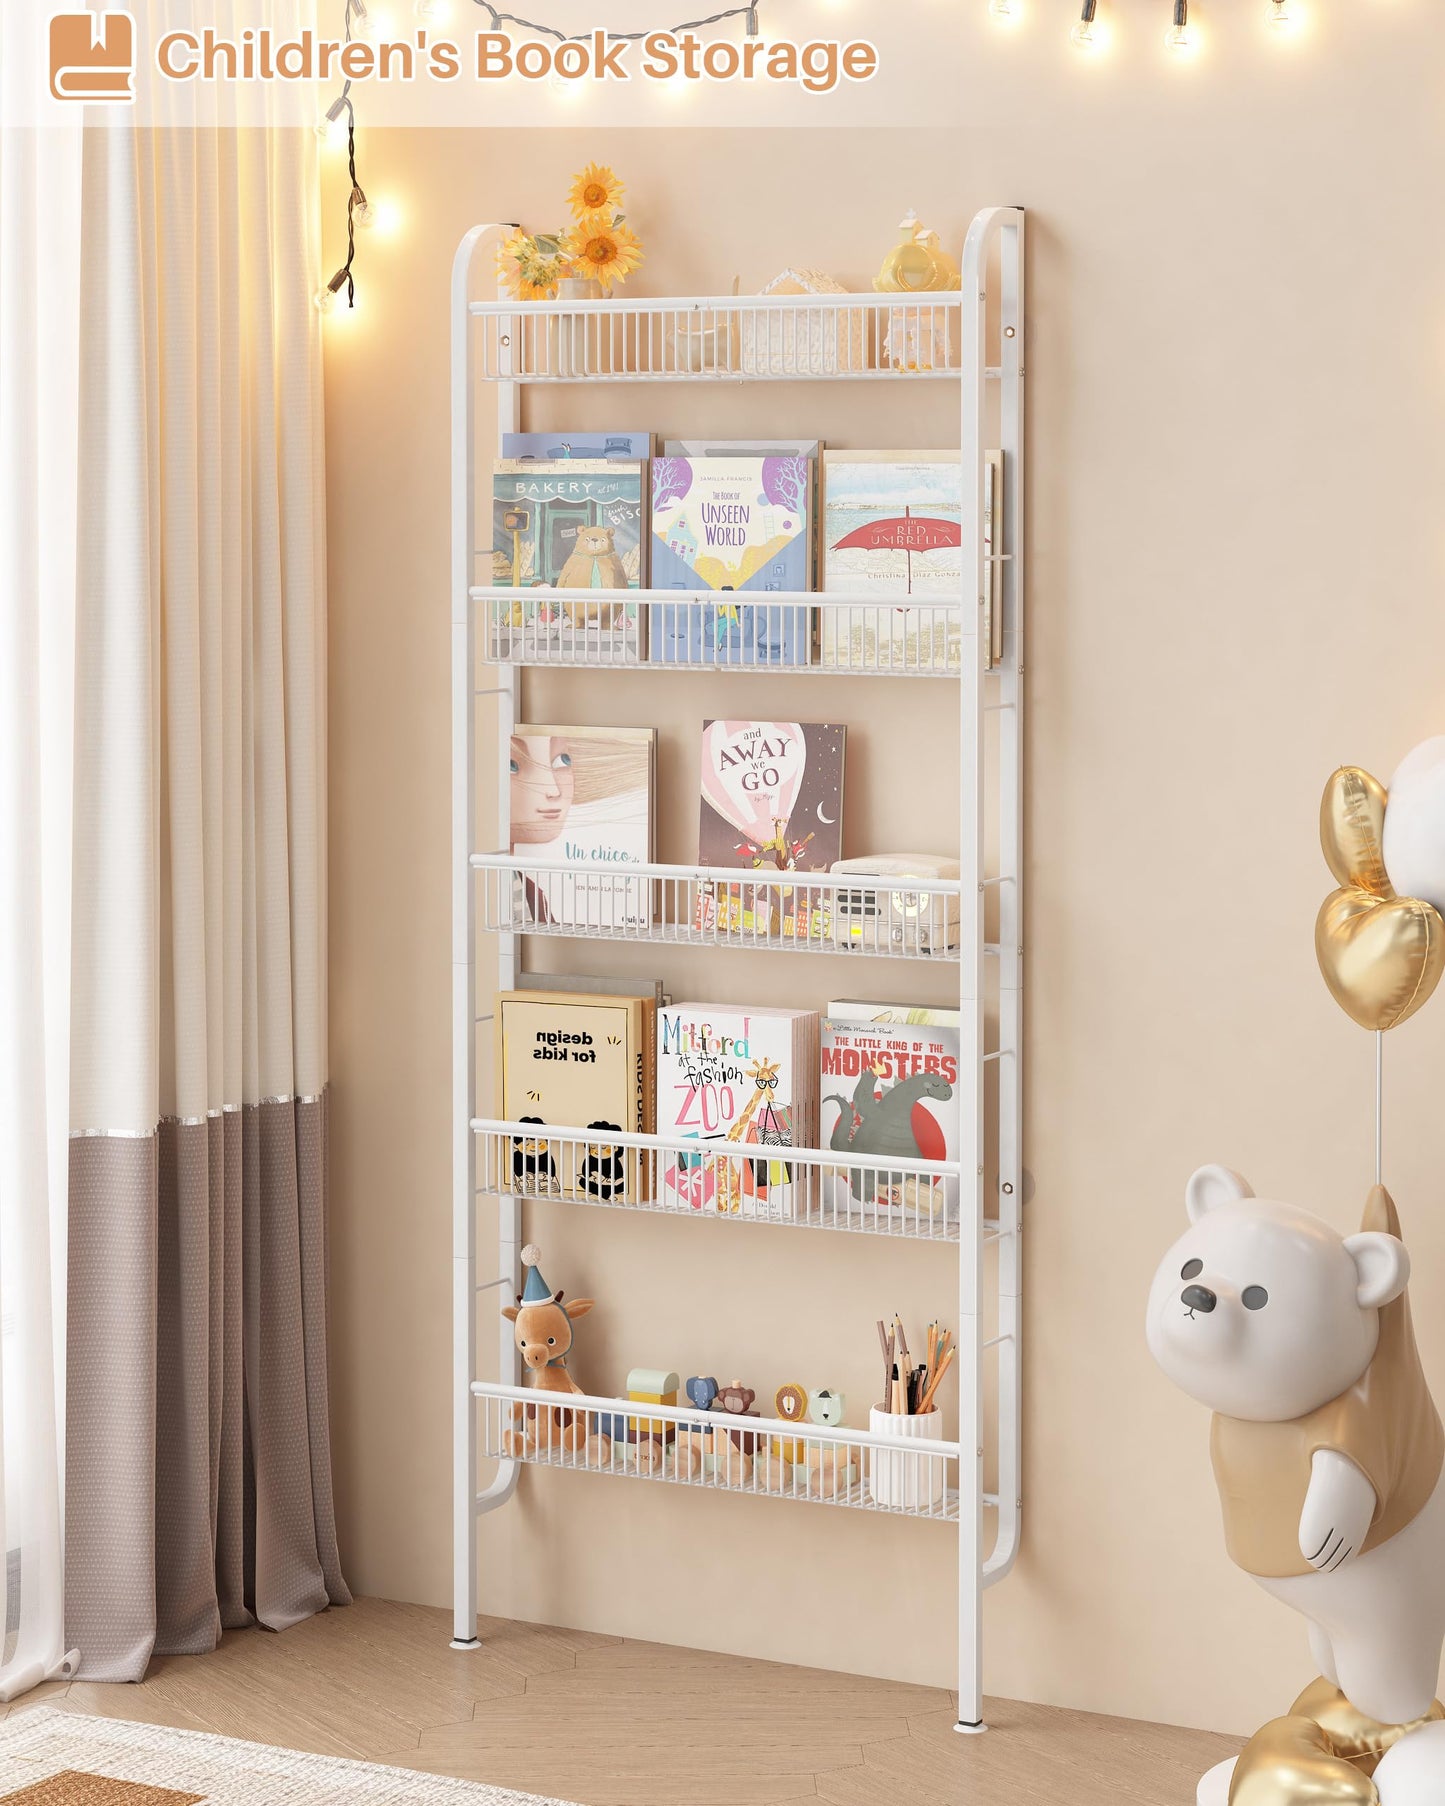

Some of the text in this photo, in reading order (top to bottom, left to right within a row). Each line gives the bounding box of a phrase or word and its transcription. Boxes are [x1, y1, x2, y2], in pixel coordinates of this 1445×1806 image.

[515, 482, 592, 494] BAKERY
[701, 502, 750, 524] UNSEEN
[705, 524, 746, 546] WORLD
[897, 525, 927, 535] RED
[871, 535, 953, 546] UMBRELLA
[743, 727, 761, 740] and
[719, 737, 792, 771] AWAY
[751, 761, 766, 770] we
[741, 768, 780, 791] GO
[565, 841, 587, 861] Un
[662, 1014, 752, 1059] Mitford
[834, 1036, 944, 1053] THE LITTLE KING OF THE
[678, 1052, 717, 1067] at the
[821, 1047, 957, 1084] MONSTERS
[683, 1062, 743, 1093] fashion
